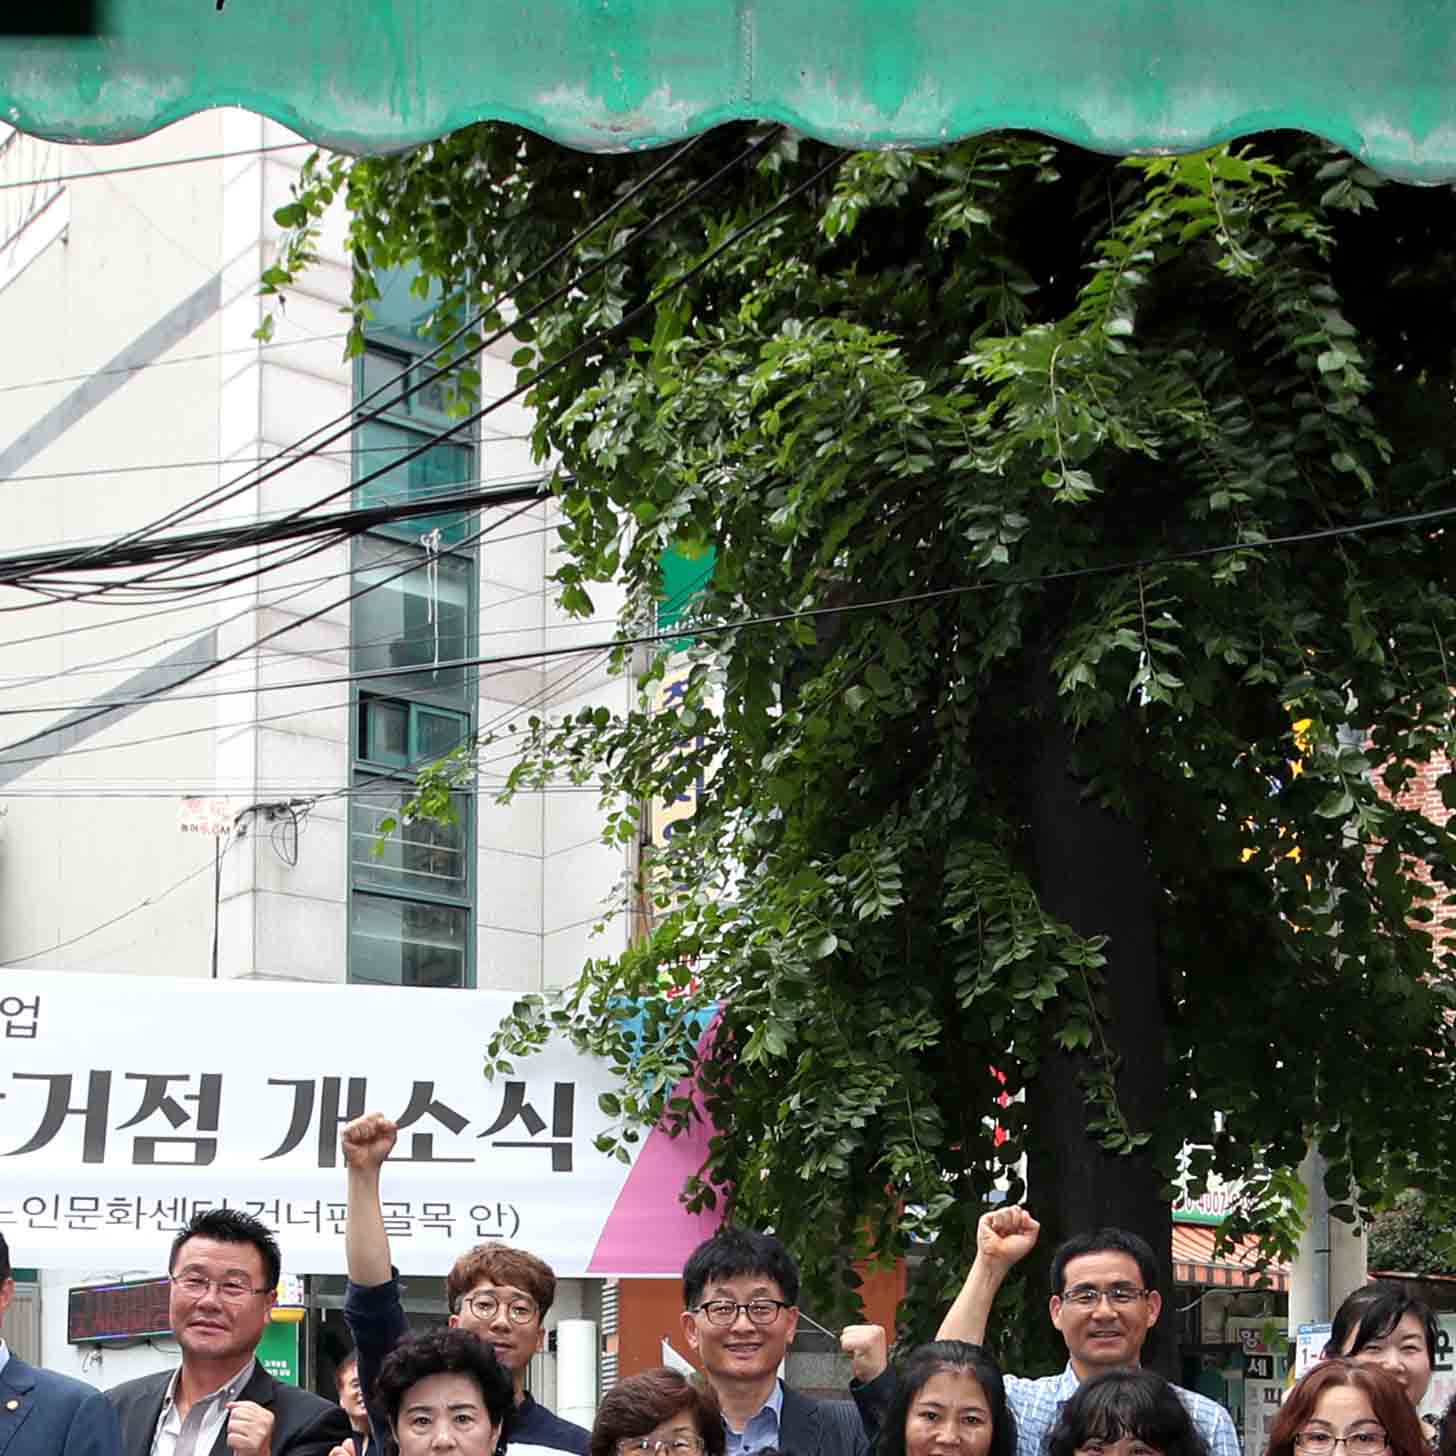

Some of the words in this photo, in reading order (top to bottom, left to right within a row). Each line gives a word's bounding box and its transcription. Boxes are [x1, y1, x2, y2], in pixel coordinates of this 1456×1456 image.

[259, 1076, 576, 1172] 개소식
[381, 1202, 457, 1238] 골목
[470, 1203, 521, 1239] 안)
